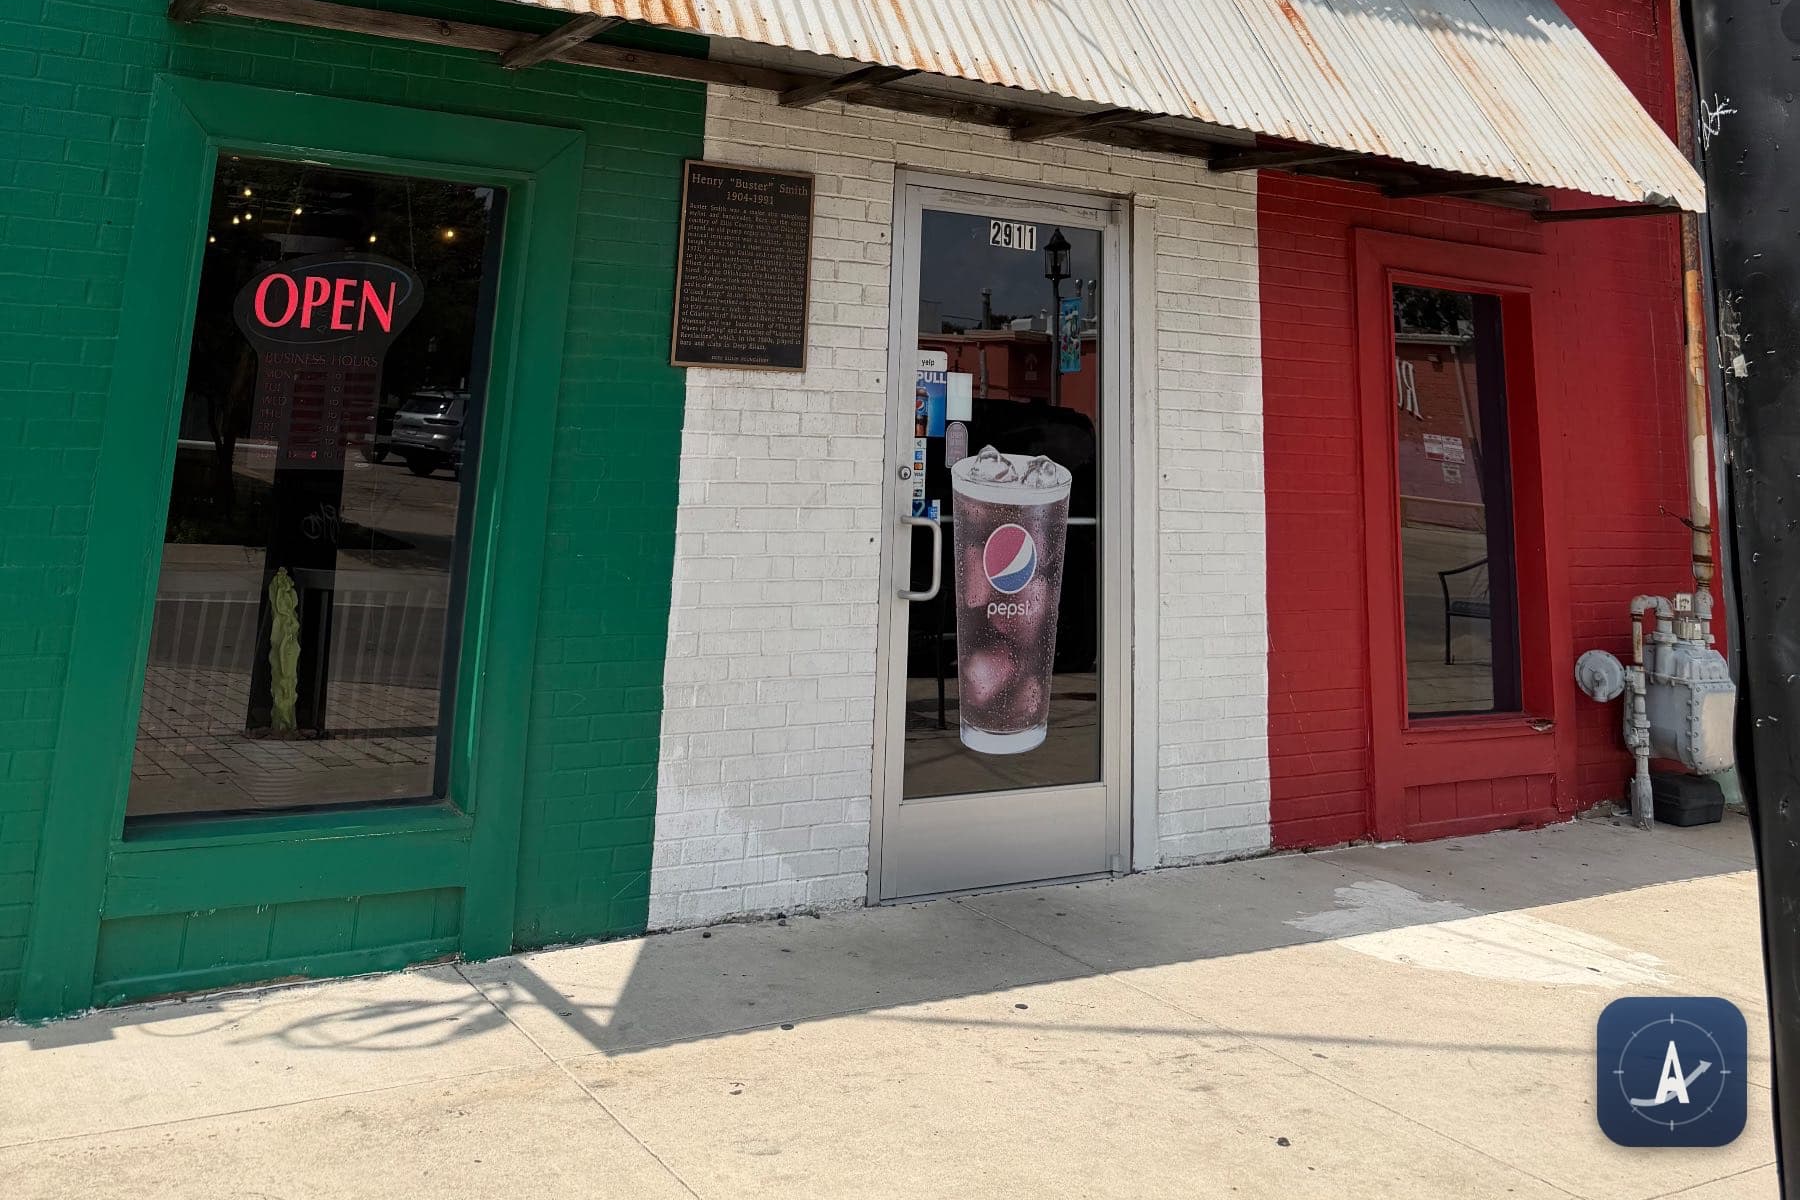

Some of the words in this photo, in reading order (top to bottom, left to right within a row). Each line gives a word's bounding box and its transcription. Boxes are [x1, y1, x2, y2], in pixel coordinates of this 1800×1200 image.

[691, 172, 724, 188] Henry
[729, 177, 773, 192] "Buster"
[778, 183, 808, 195] Smith
[726, 191, 774, 205] 1904-1991
[991, 220, 1037, 252] 2911
[254, 272, 397, 333] OPEN
[331, 354, 379, 369] HOURS
[916, 371, 947, 384] PULL
[987, 600, 1032, 620] pepsi
